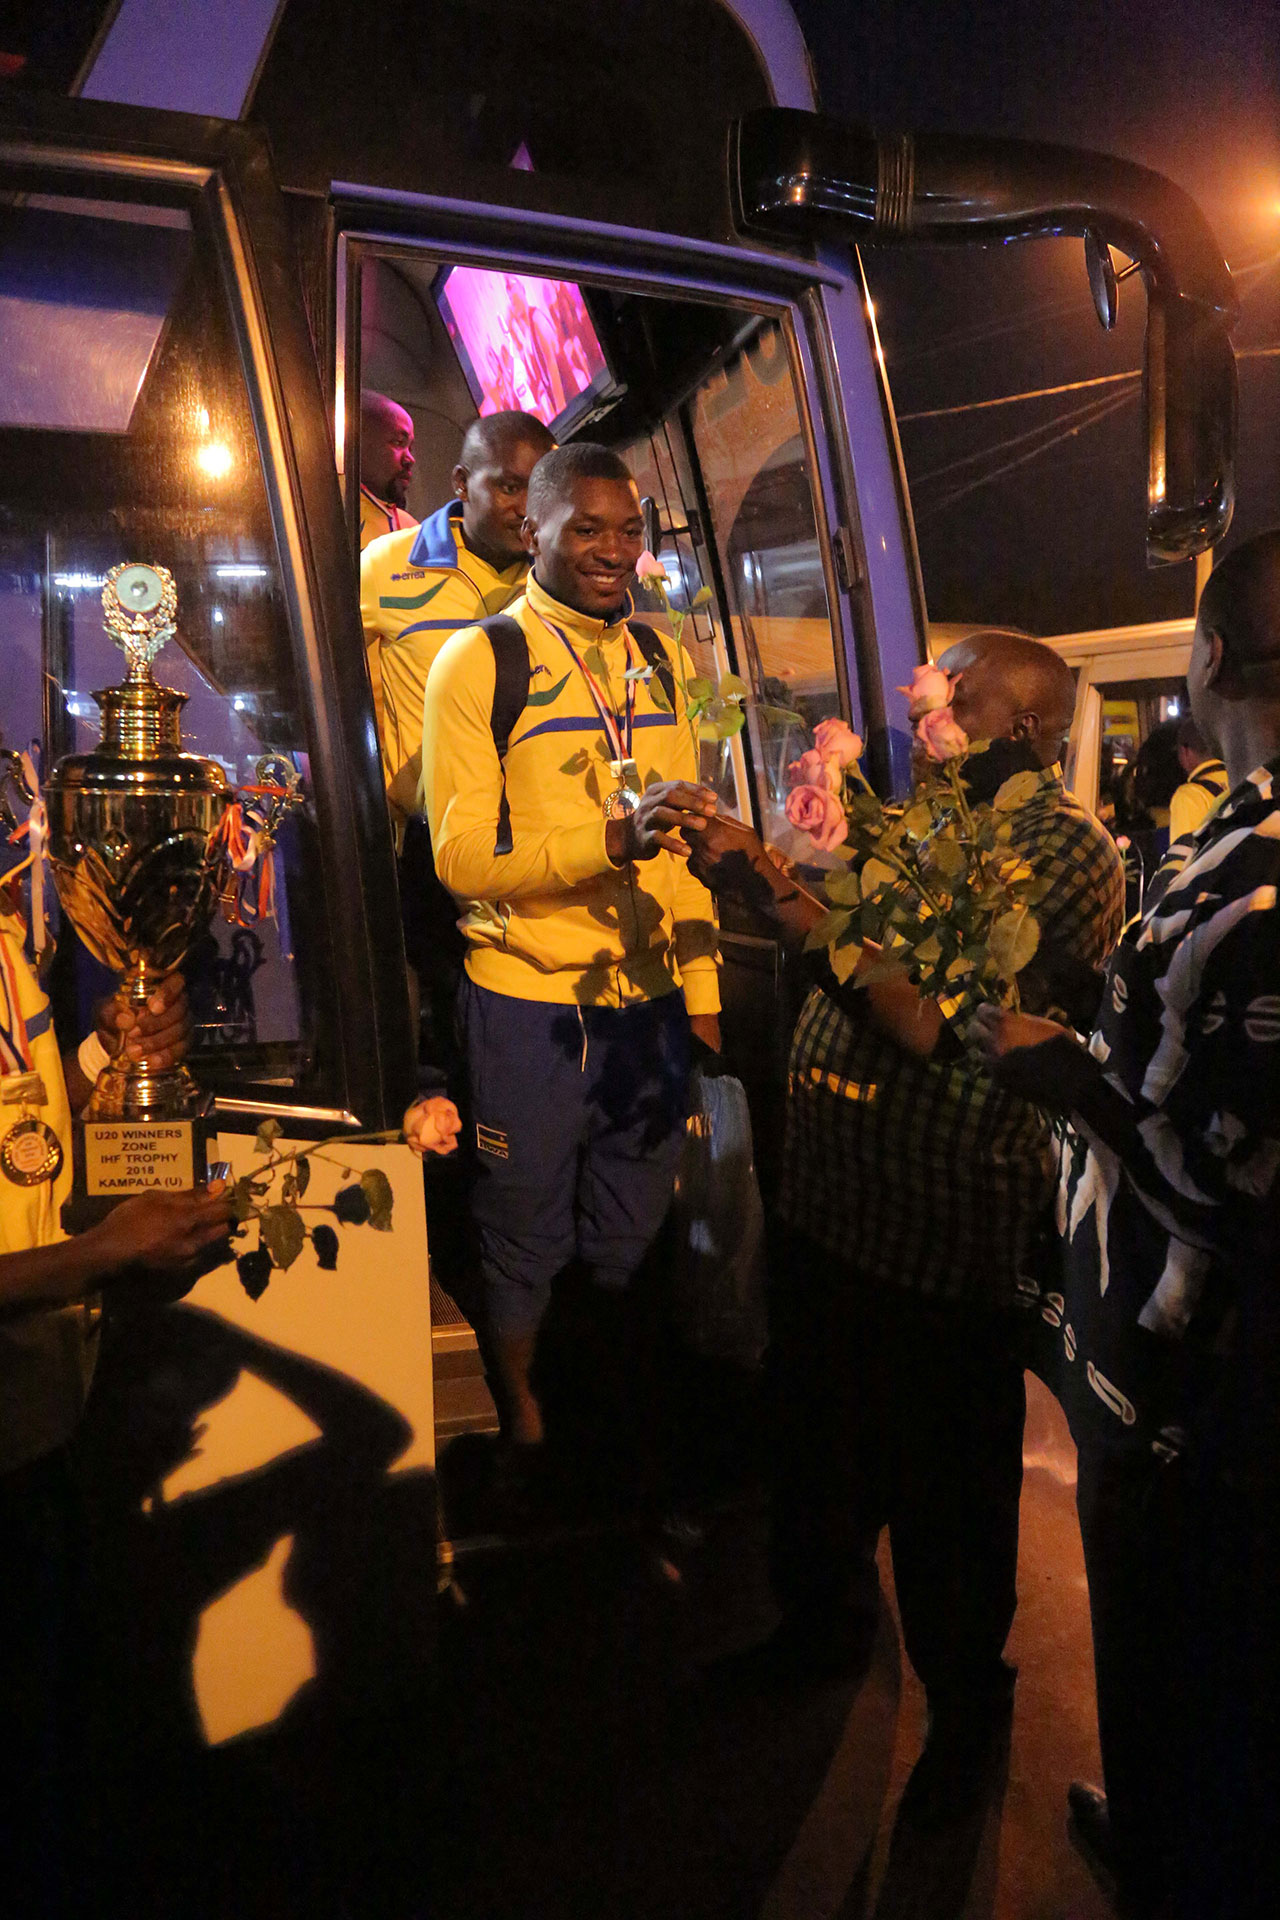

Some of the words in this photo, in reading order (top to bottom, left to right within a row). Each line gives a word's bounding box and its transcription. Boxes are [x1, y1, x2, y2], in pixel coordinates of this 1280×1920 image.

[95, 1131, 118, 1140] U20
[122, 1129, 182, 1139] WINNERS
[121, 1142, 157, 1151] ZONE
[100, 1155, 121, 1163] IHF
[125, 1153, 178, 1163] TROPHY
[126, 1166, 154, 1175] 2018
[98, 1178, 162, 1188] KAMPALA
[165, 1177, 183, 1187] (U)
